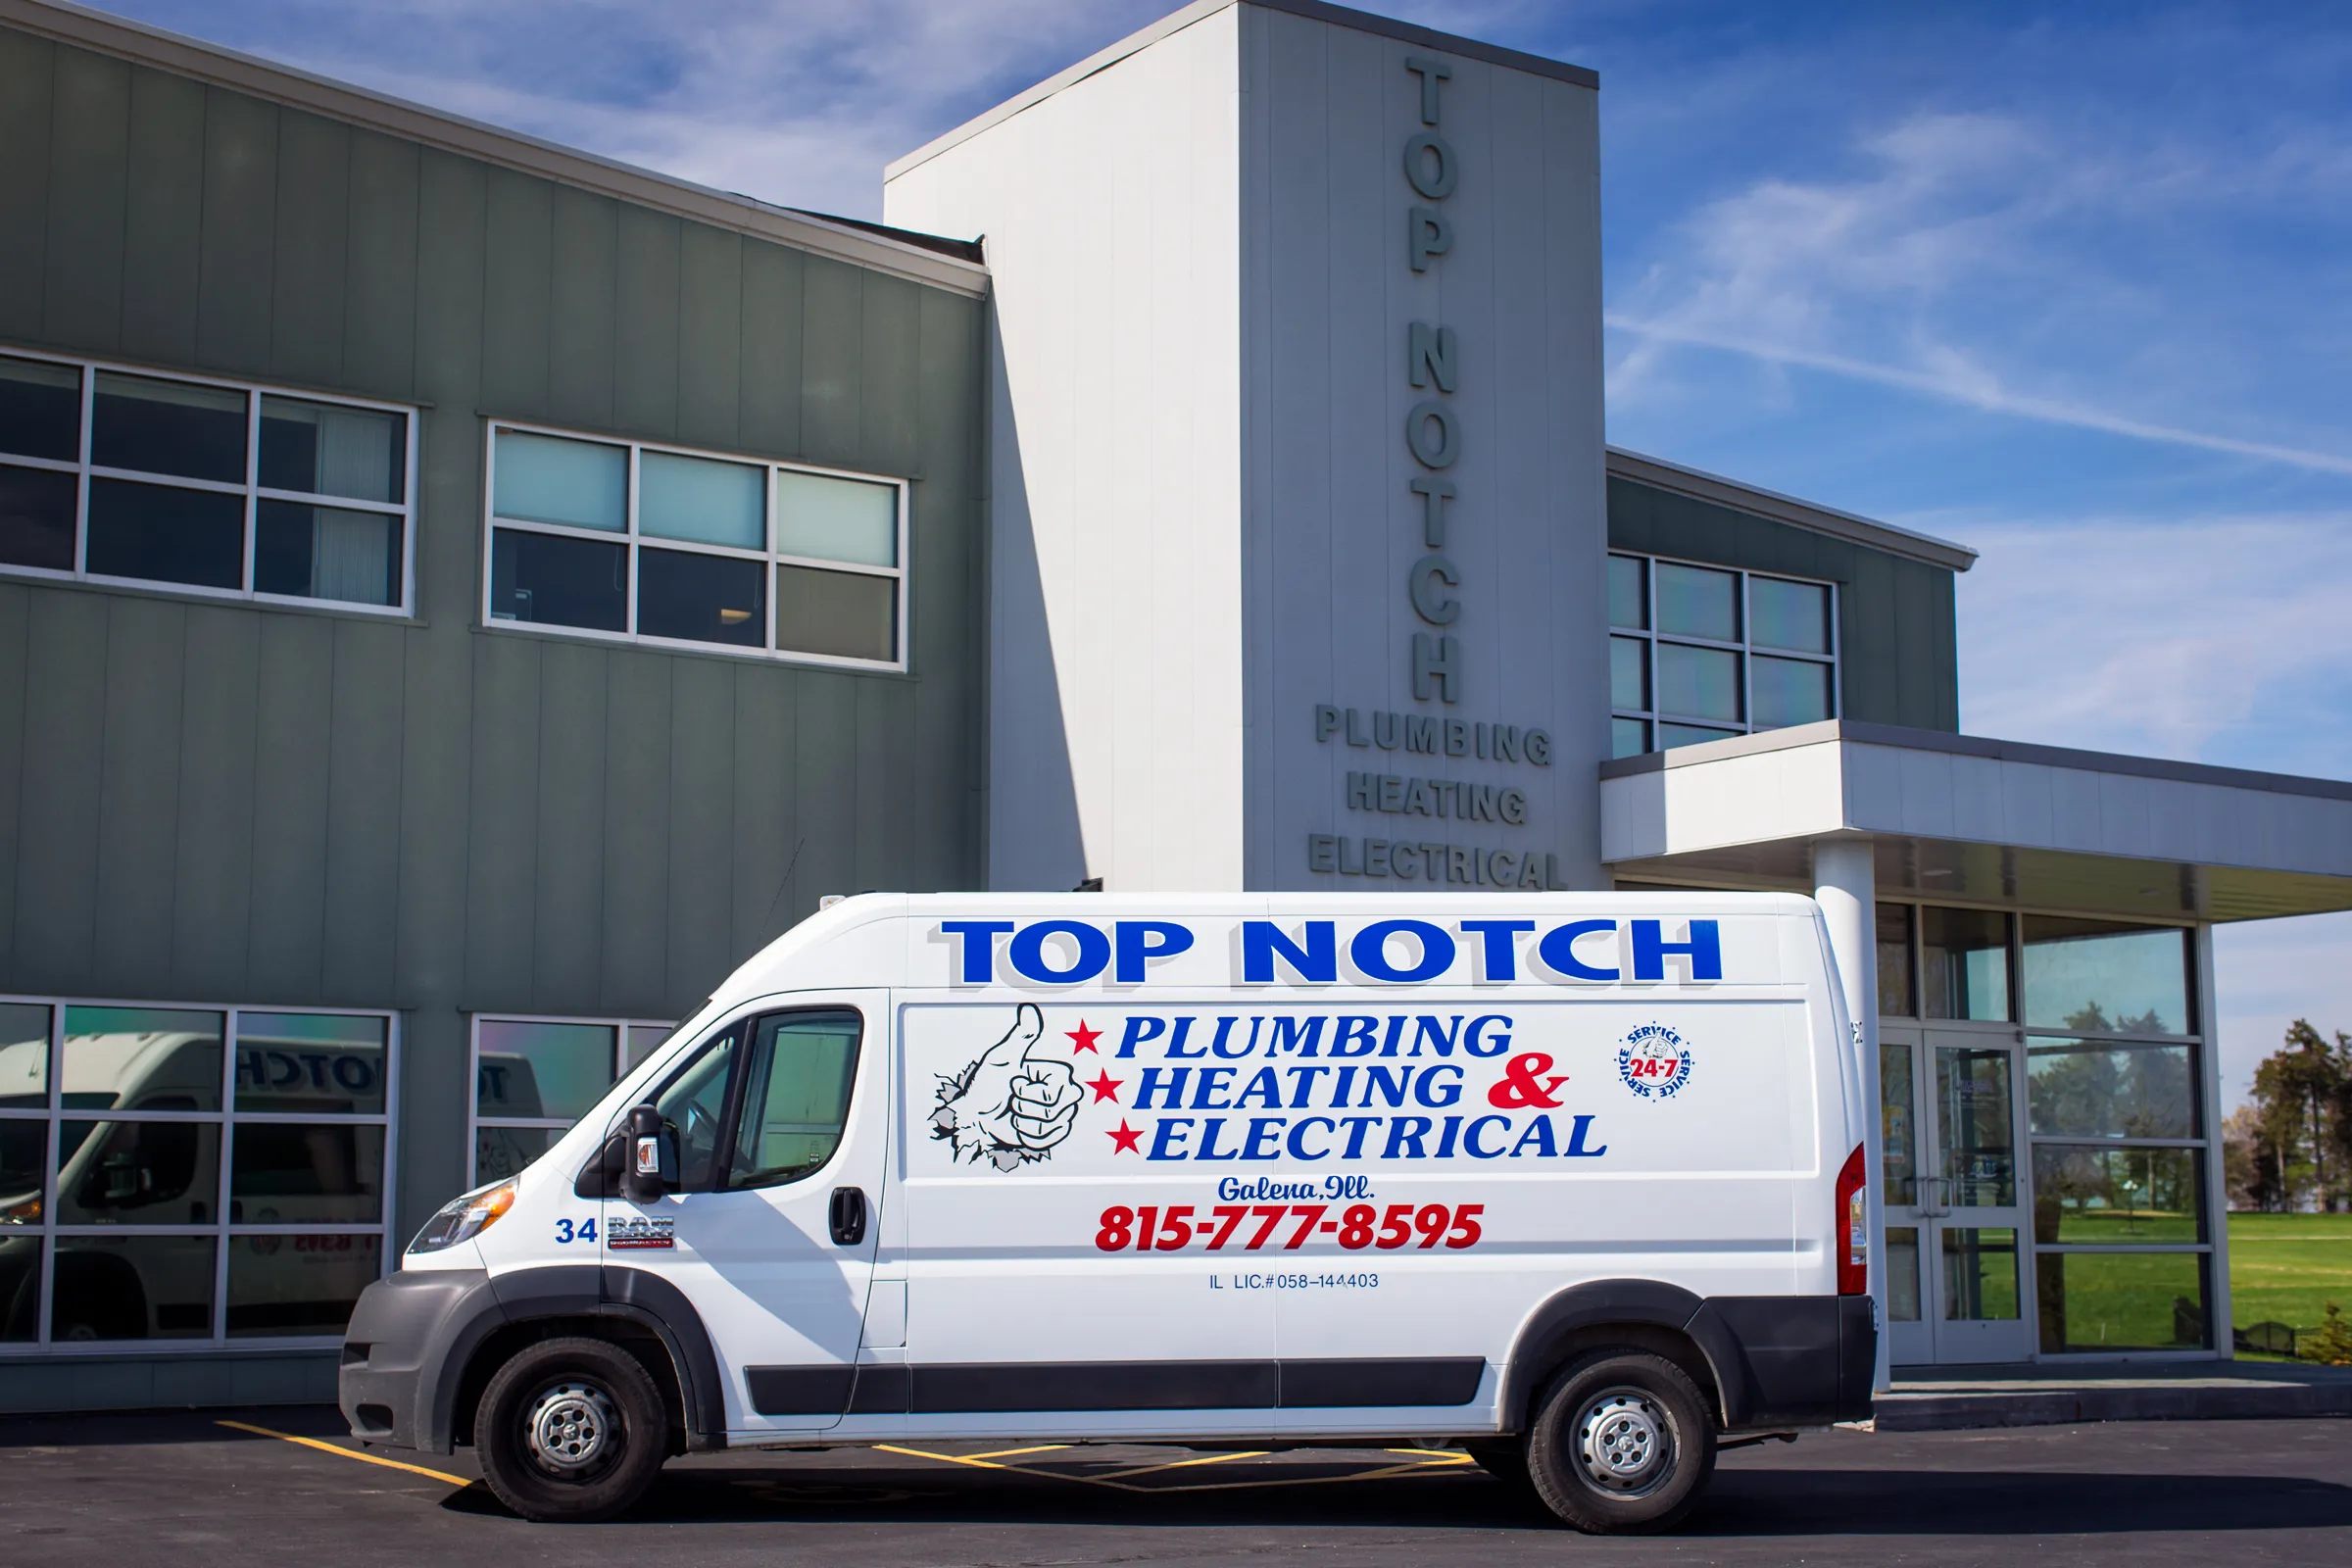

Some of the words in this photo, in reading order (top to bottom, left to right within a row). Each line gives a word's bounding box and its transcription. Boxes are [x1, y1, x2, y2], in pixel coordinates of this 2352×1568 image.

[1405, 55, 1458, 273] TOP
[1407, 320, 1461, 704] NOTCH
[1315, 704, 1552, 766] PLUMBING
[1347, 770, 1528, 825] HEATING
[1308, 834, 1569, 891] ELECTRICAL
[940, 920, 1195, 984] TOP
[1242, 919, 1724, 983] NOTCH
[1114, 1014, 1513, 1059] PLUMBING
[1627, 1025, 1682, 1046] SERVICE
[1131, 1064, 1464, 1110] HEATING
[1487, 1052, 1570, 1109] &
[1619, 1048, 1651, 1098] SERVICE
[1630, 1058, 1679, 1078] 24-7
[1658, 1050, 1691, 1098] SERVICE
[1146, 1114, 1608, 1161] ELECTRICAL
[555, 1218, 598, 1244] 34
[608, 1216, 674, 1227] RAM
[1095, 1203, 1485, 1251] 815-777-8595
[1209, 1274, 1224, 1289] IL
